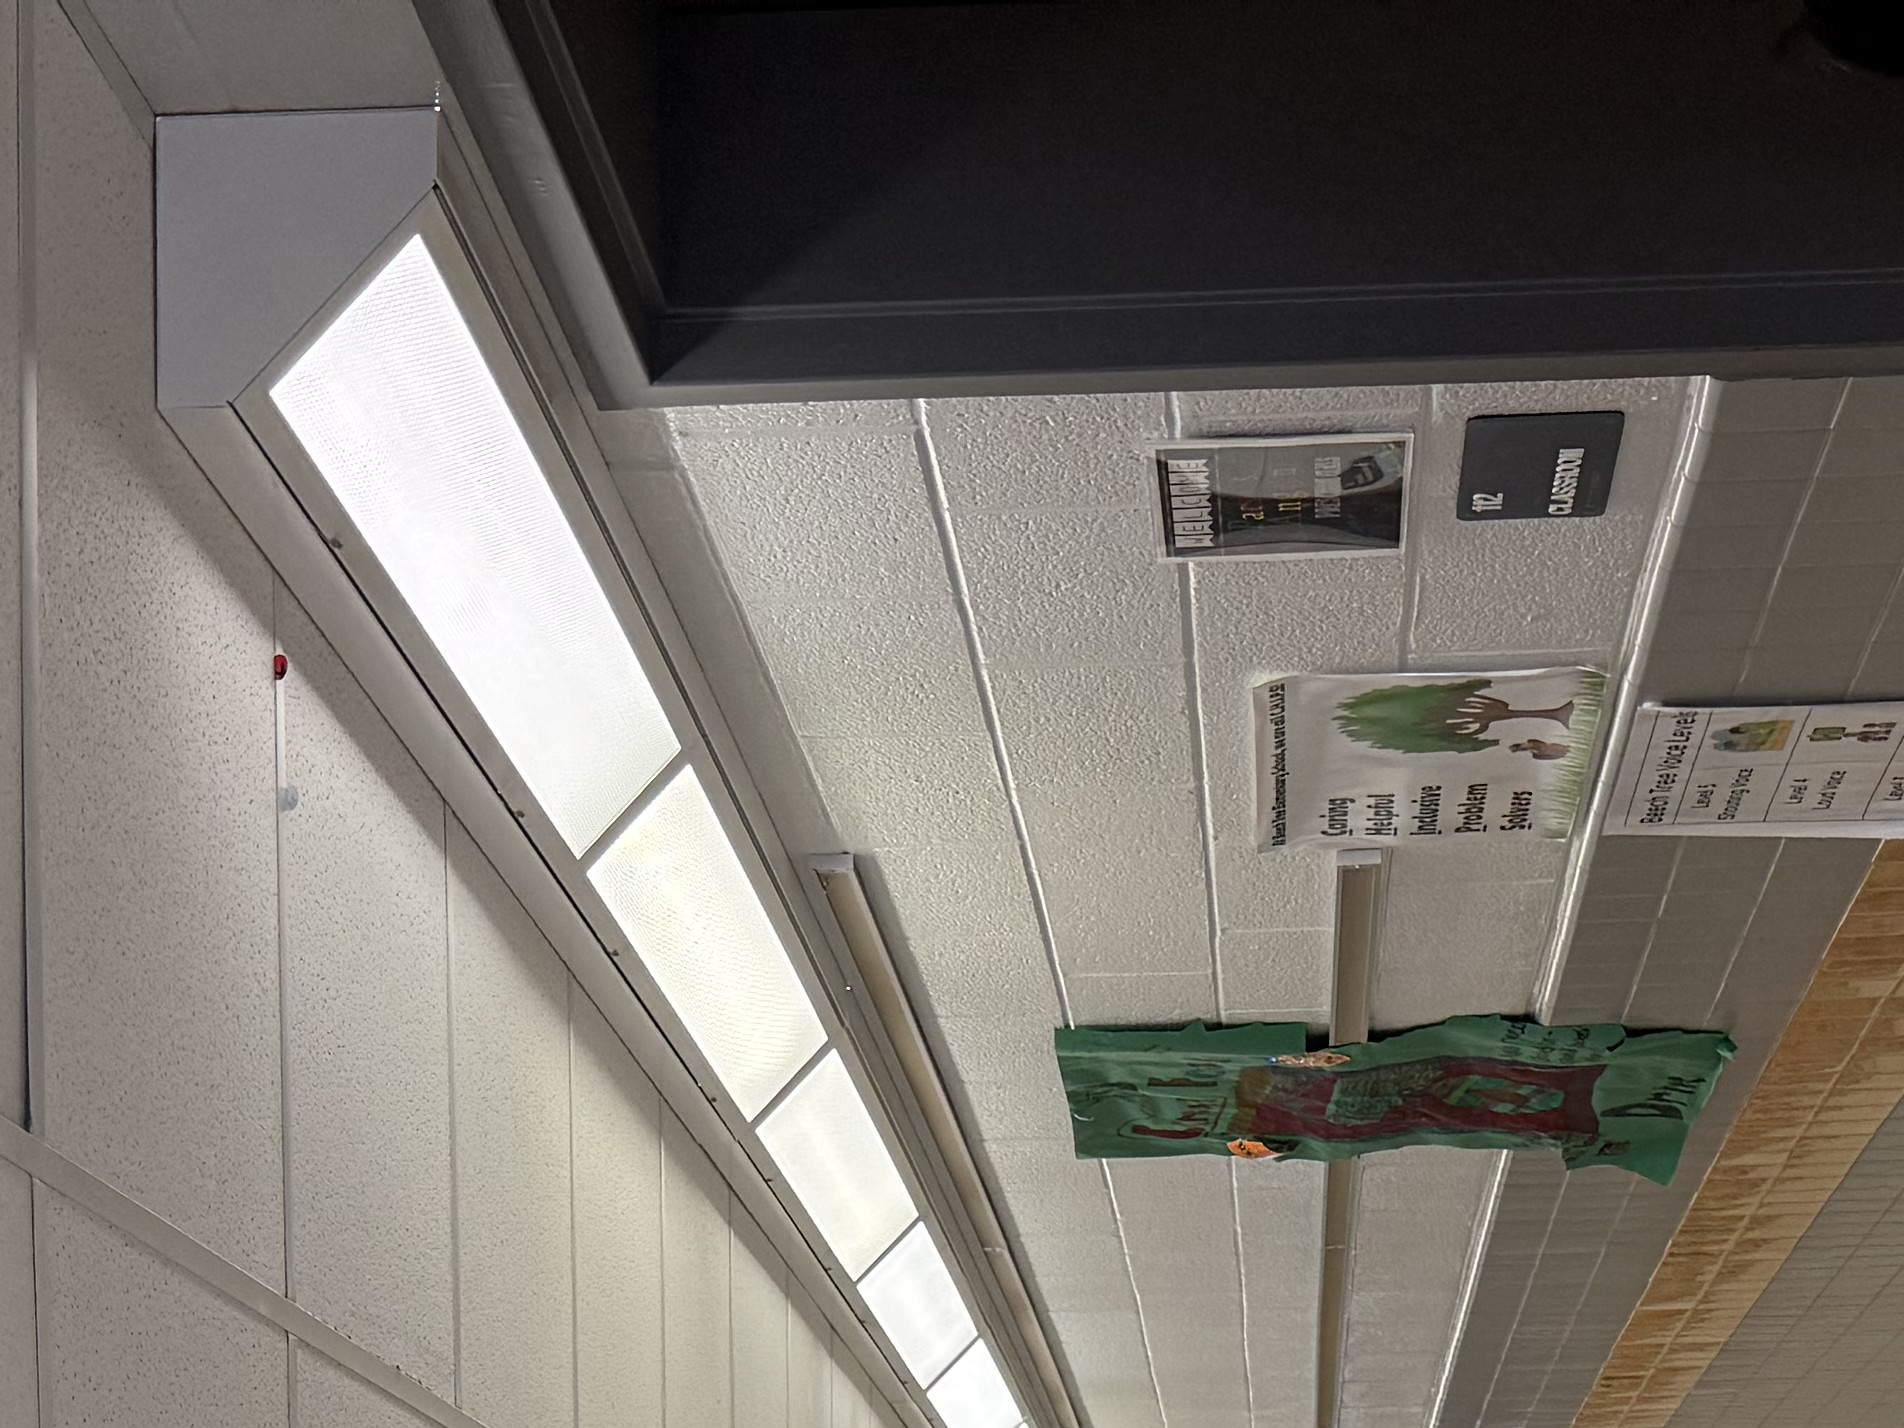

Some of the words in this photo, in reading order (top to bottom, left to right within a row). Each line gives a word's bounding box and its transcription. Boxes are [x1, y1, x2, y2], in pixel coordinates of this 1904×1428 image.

[1548, 448, 1585, 514] CLASSROOM
[1177, 460, 1205, 544] WELCOME
[1472, 493, 1504, 512] 112
[1663, 711, 1698, 743] Levels
[1655, 745, 1688, 771] Voice
[1648, 773, 1678, 794] Tree
[1691, 790, 1714, 808] Level
[1784, 785, 1807, 804] Level
[1365, 794, 1399, 836] Helpful
[1410, 786, 1441, 836] Inclusive
[1455, 784, 1487, 833] Problem
[1500, 791, 1533, 831] Solvers
[1640, 795, 1669, 823] Beech
[1717, 789, 1750, 820] Shouting
[1812, 792, 1836, 810] Loud
[1319, 798, 1355, 836] Caring
